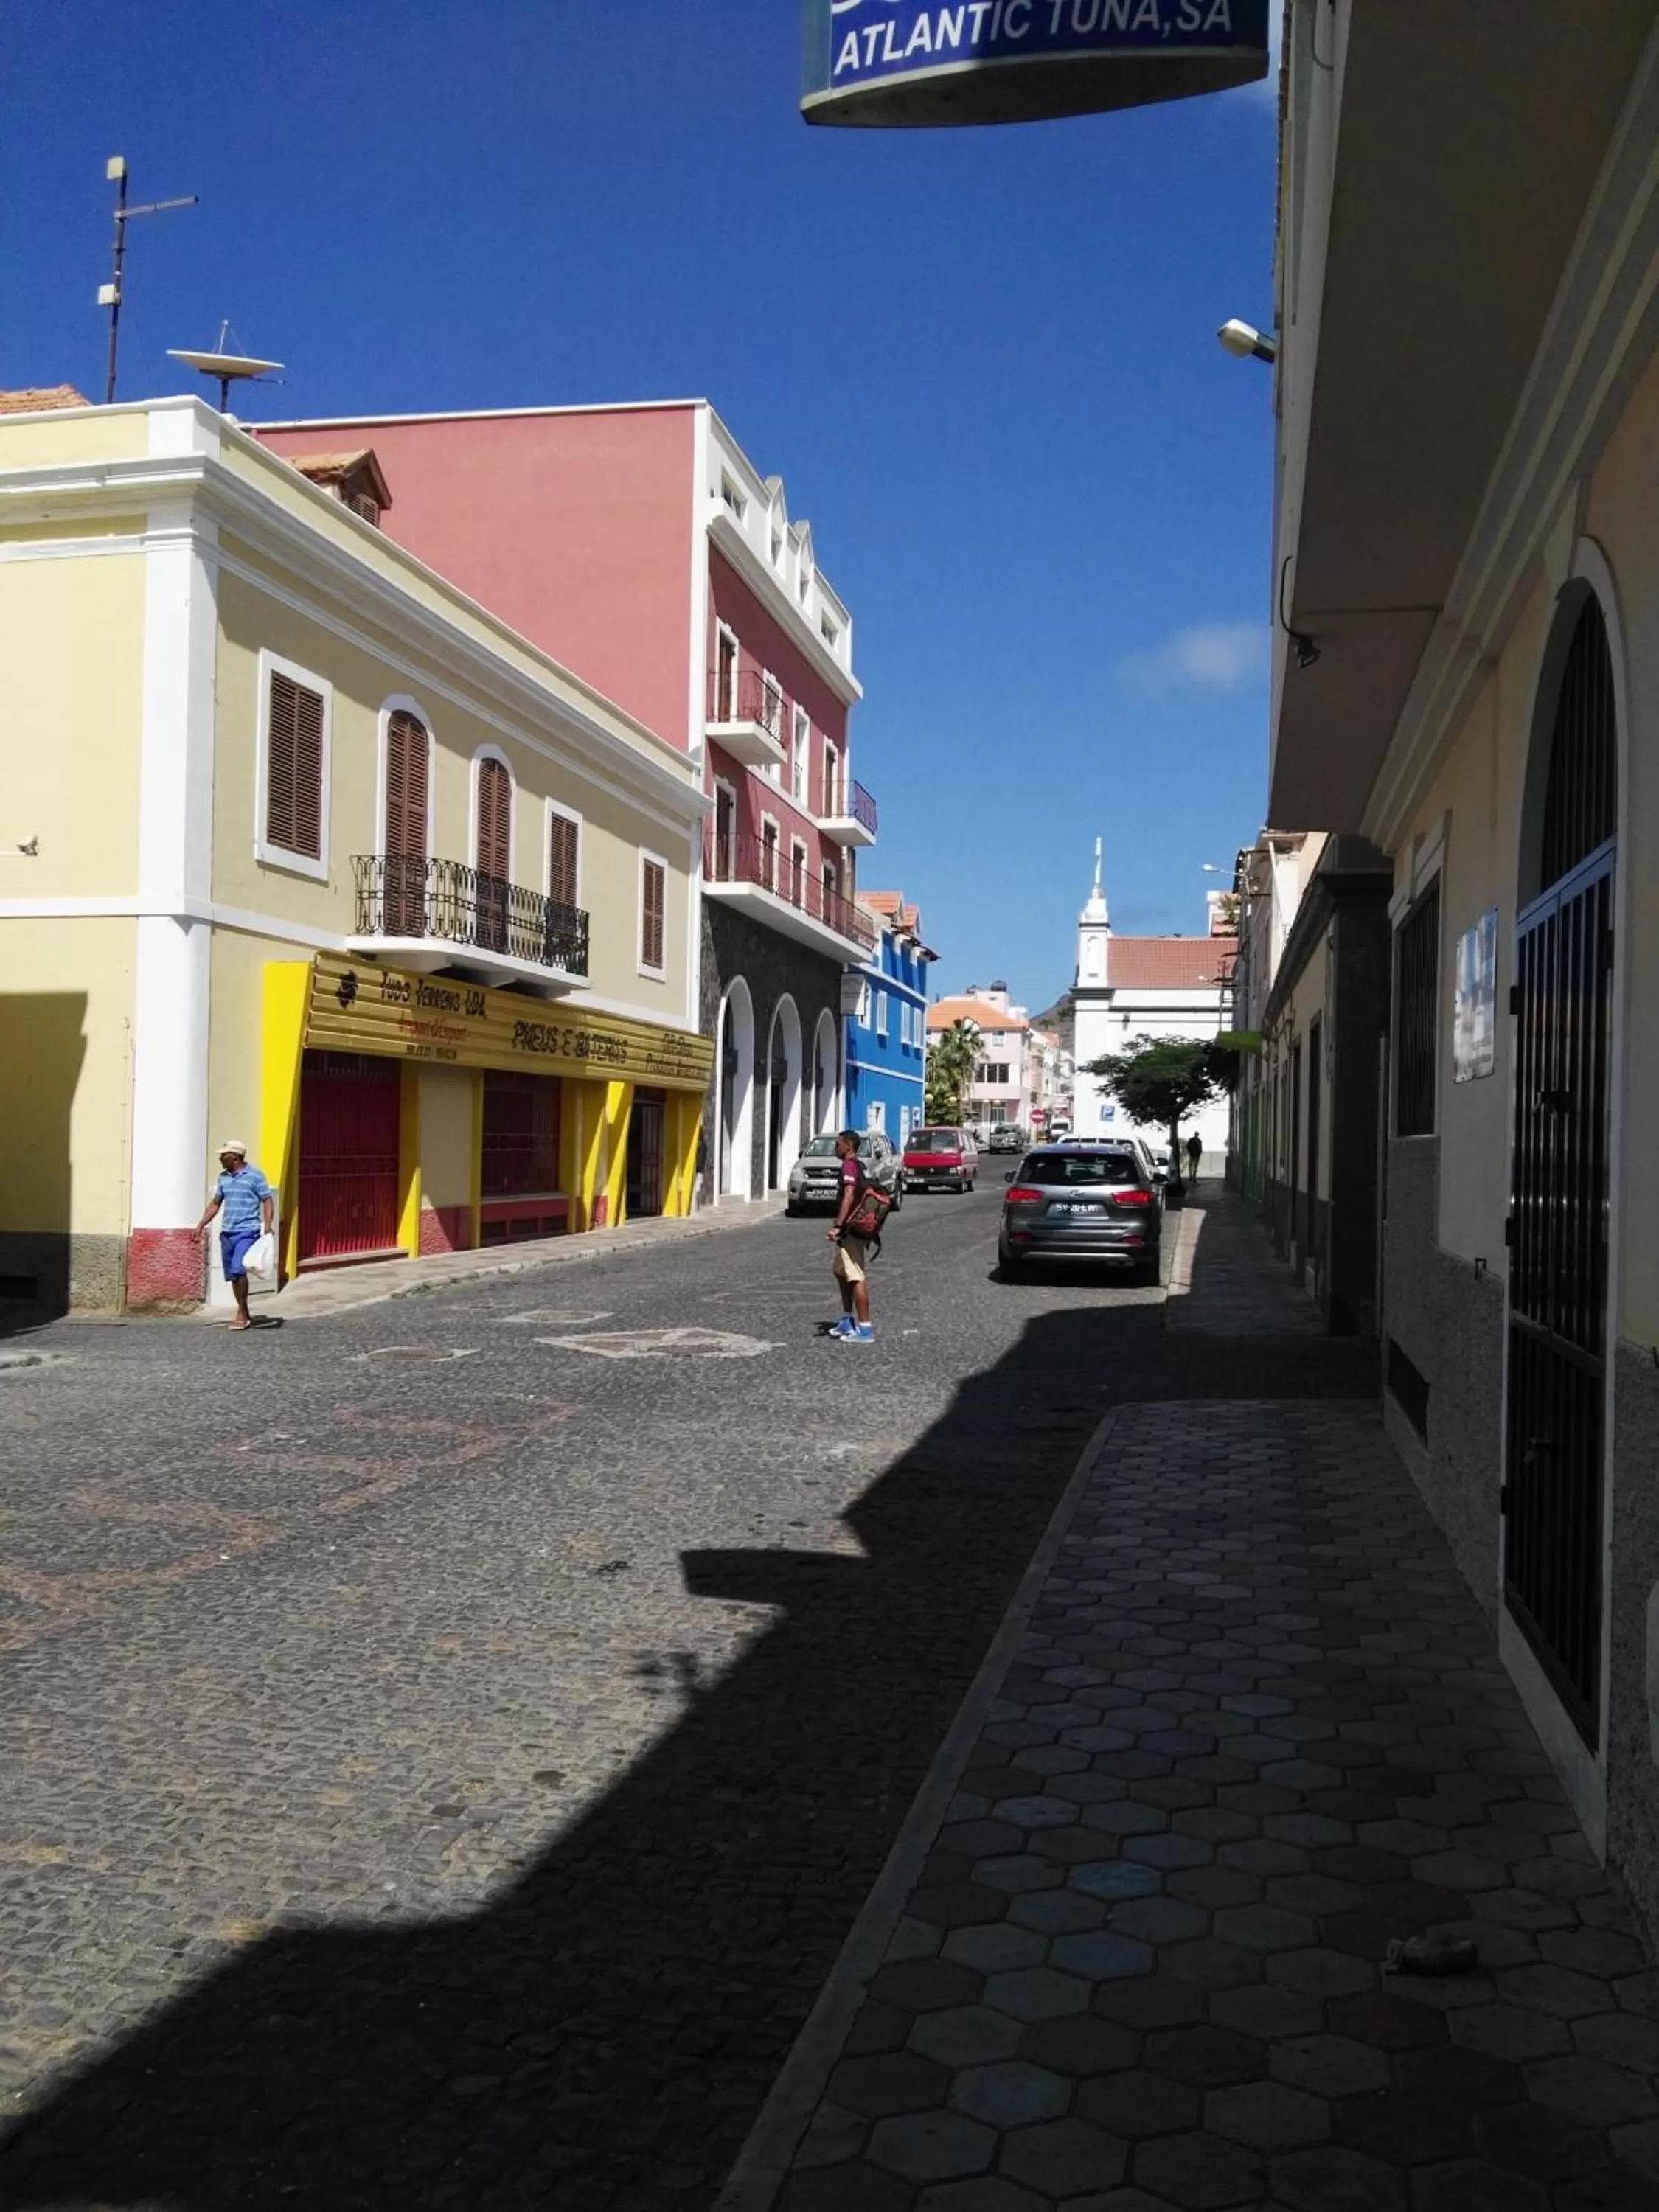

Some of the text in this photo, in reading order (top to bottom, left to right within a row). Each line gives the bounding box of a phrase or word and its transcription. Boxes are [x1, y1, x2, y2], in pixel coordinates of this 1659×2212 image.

[833, 0, 1032, 75] ATLANTIC
[511, 1020, 559, 1054] PNEUS
[561, 1029, 574, 1057] E
